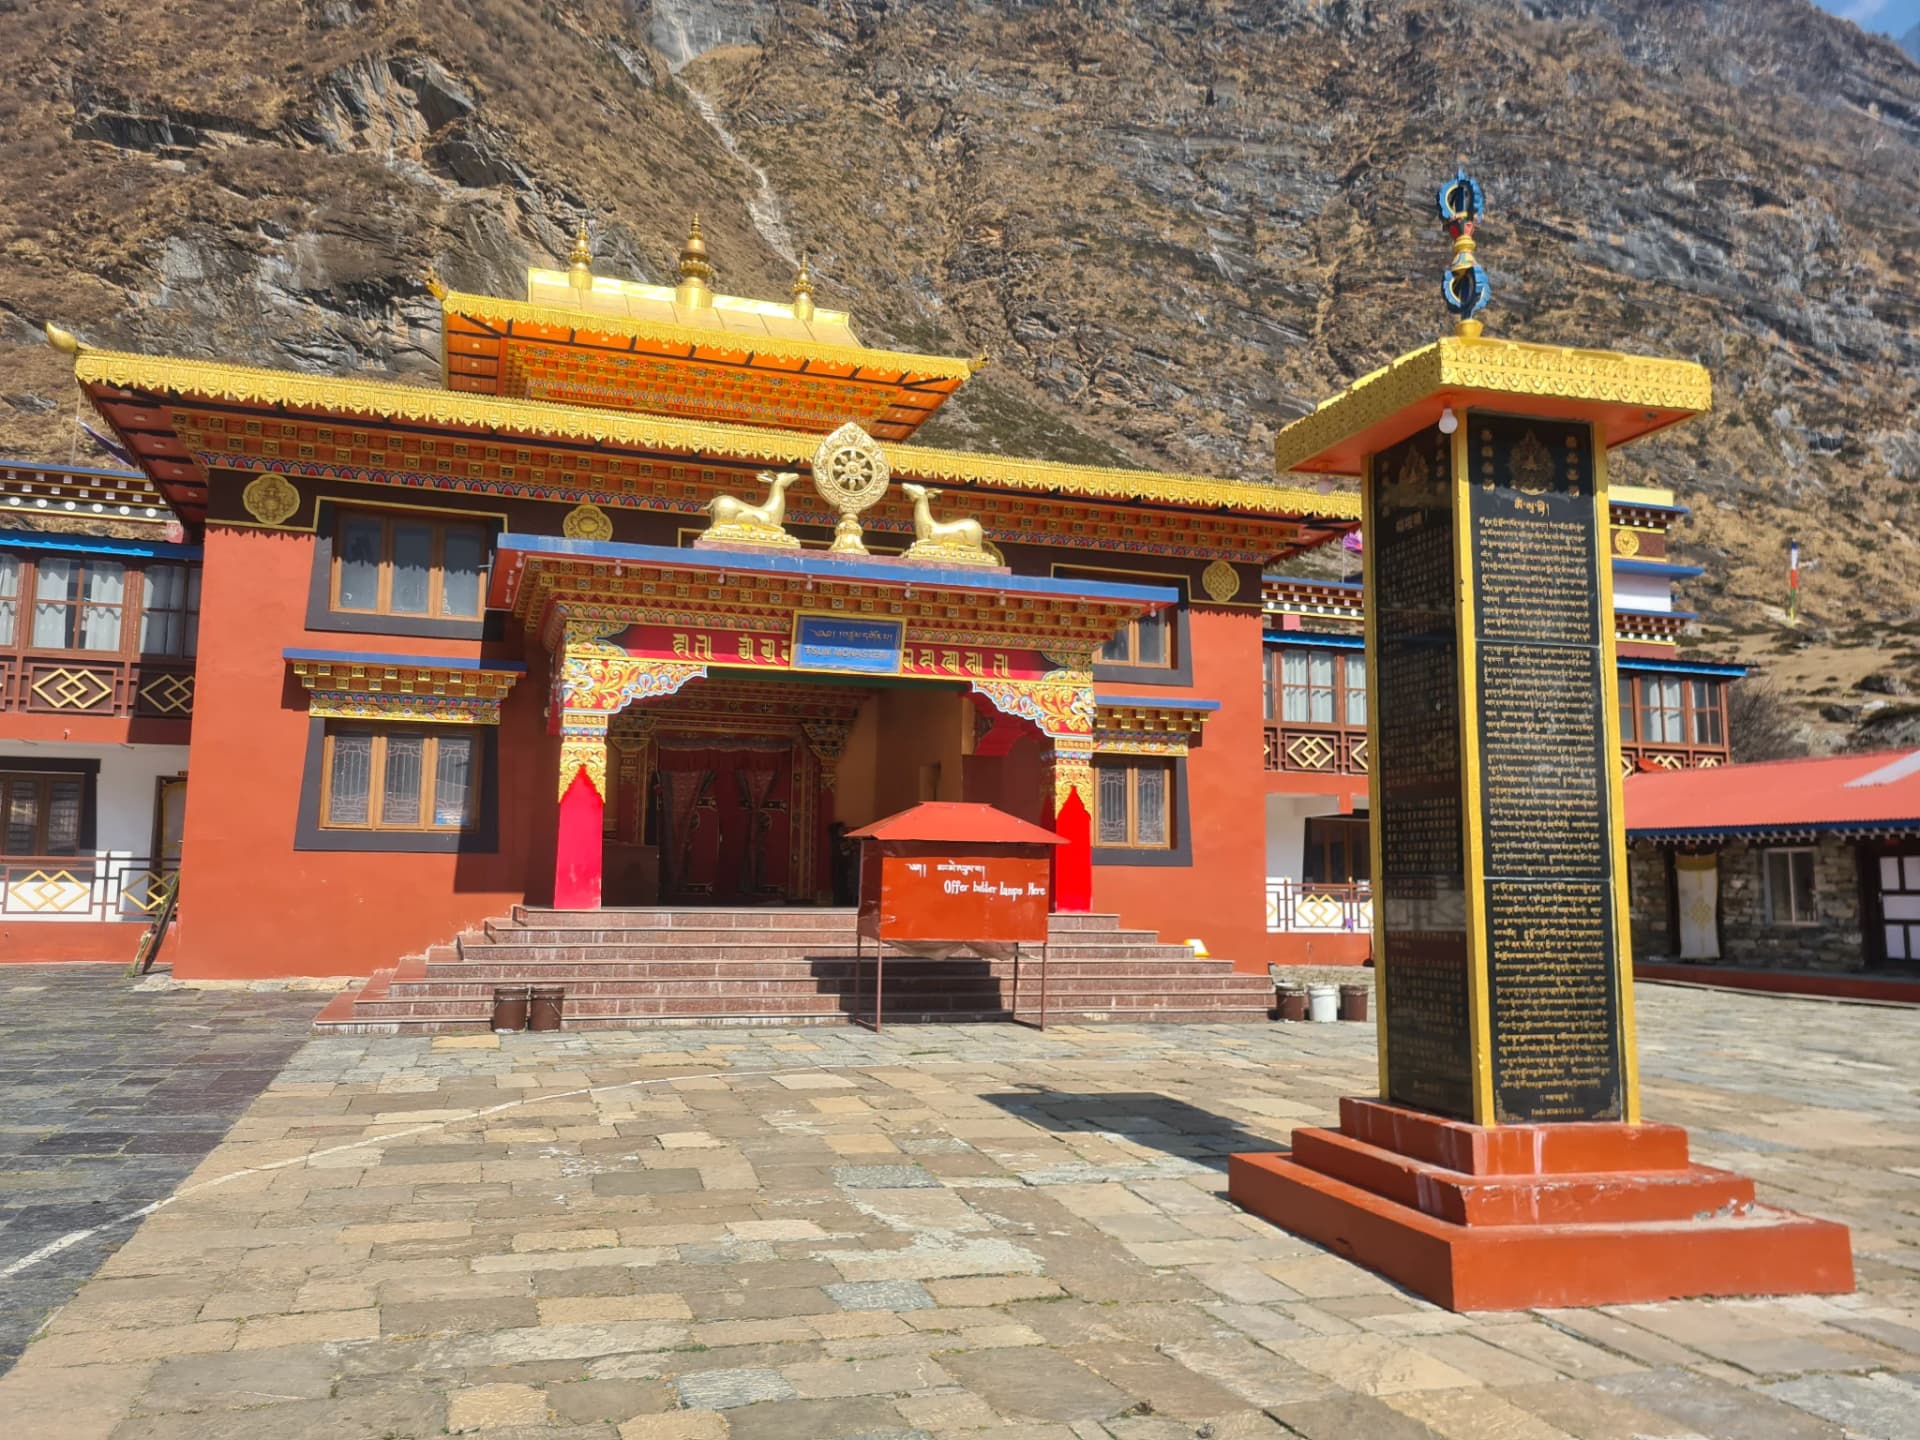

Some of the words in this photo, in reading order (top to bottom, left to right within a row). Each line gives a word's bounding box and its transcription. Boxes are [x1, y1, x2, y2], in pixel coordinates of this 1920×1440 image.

[804, 647, 832, 657] TSUM
[834, 648, 890, 659] MONASTERY
[944, 880, 969, 894] Offer
[973, 881, 997, 894] butter
[1027, 882, 1046, 896] Here
